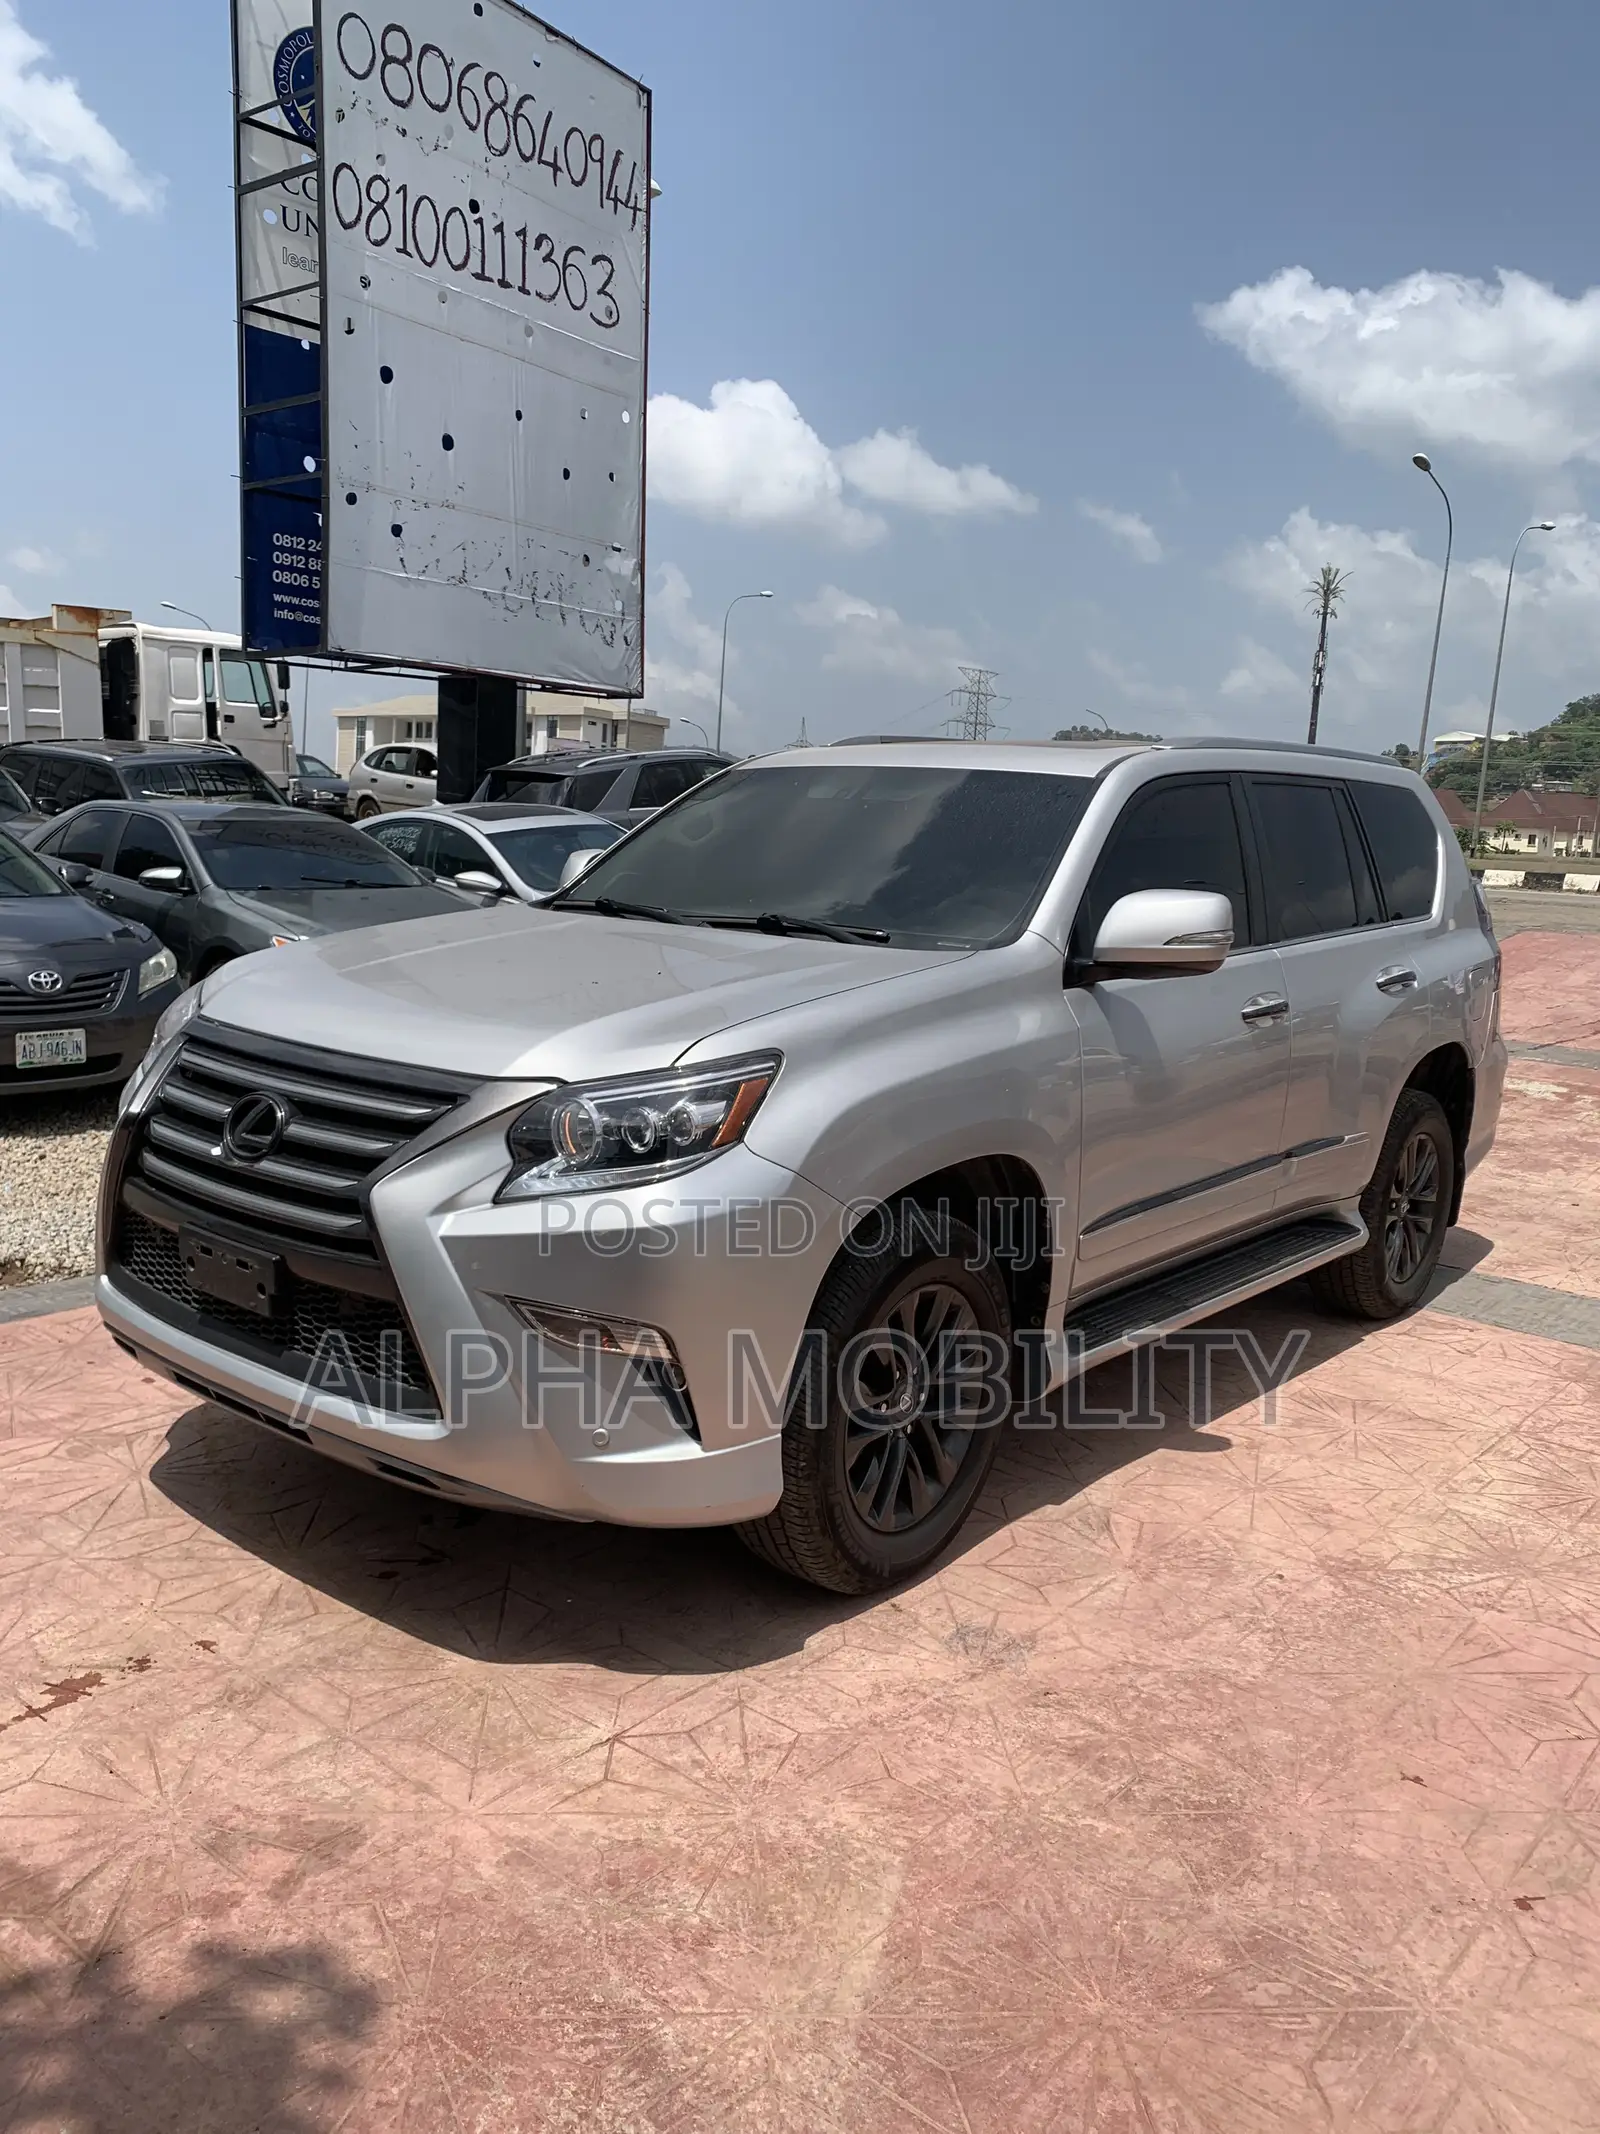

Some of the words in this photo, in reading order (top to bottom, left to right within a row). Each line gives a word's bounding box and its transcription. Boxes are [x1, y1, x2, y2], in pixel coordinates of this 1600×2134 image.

[337, 12, 646, 231] 08068640944
[332, 162, 620, 328] 08100111363
[272, 532, 306, 551] 0812
[272, 551, 306, 569] 0912
[272, 569, 309, 588] 0806
[272, 593, 320, 608] www.cos
